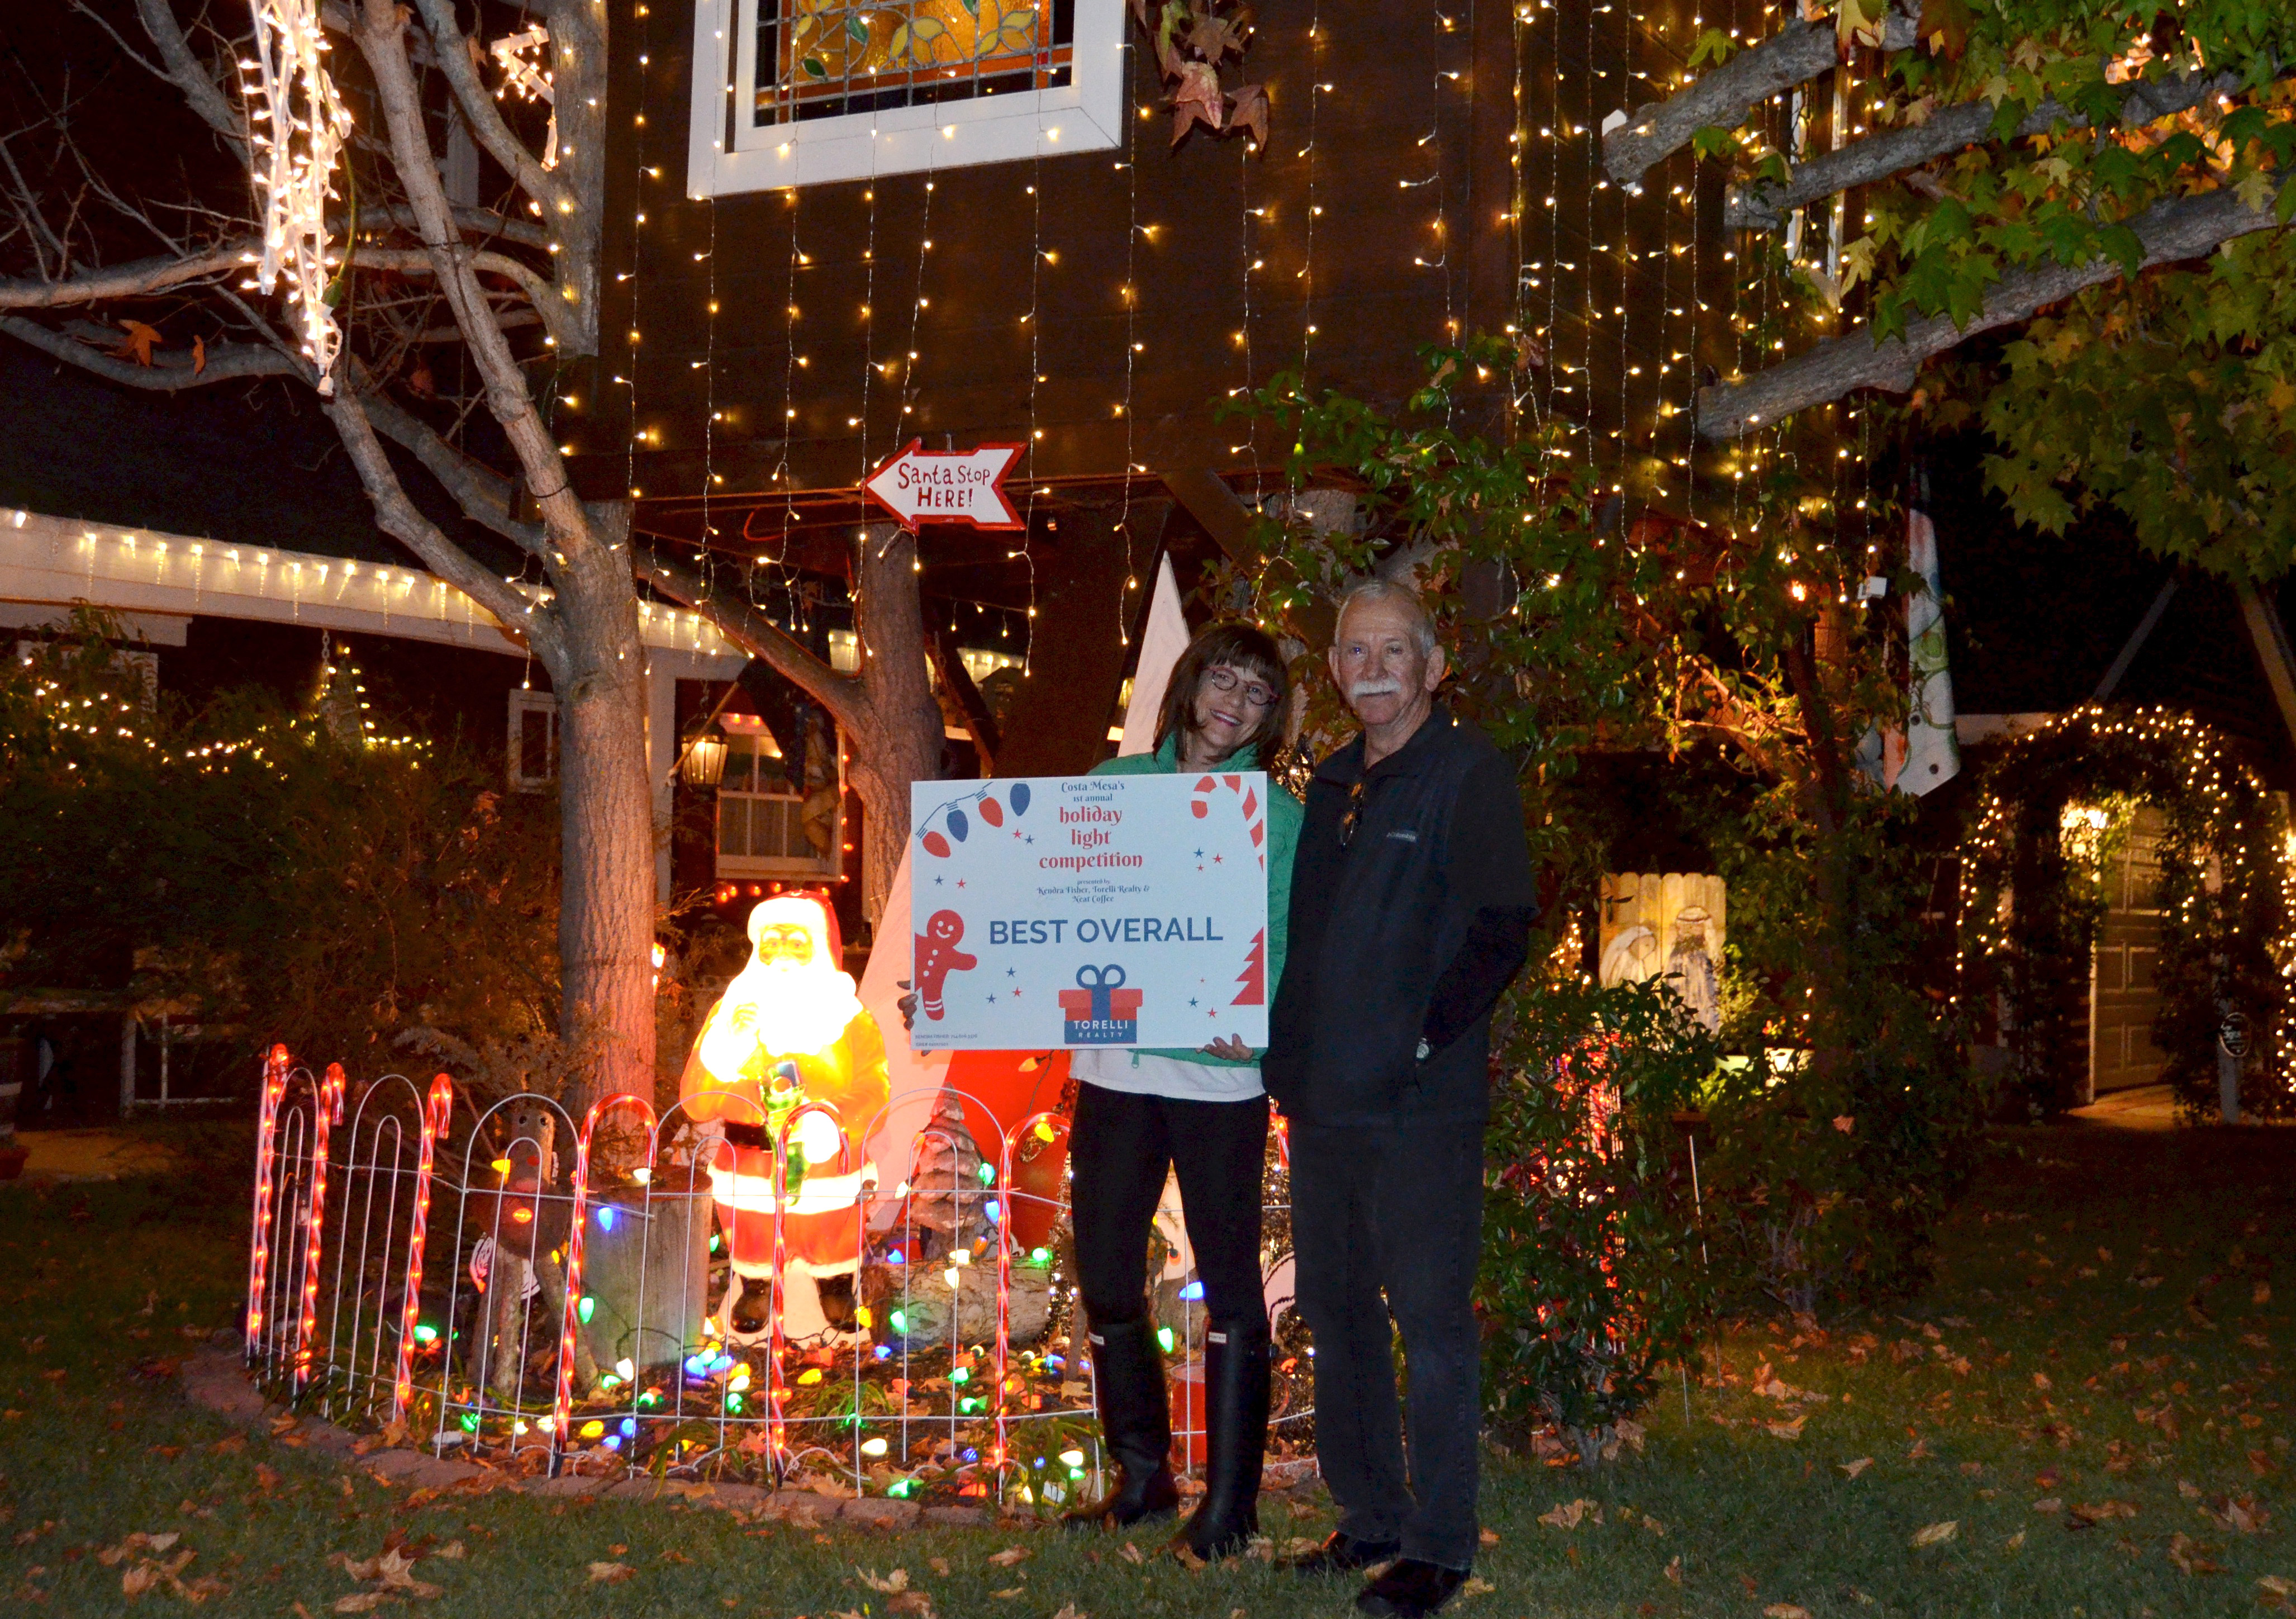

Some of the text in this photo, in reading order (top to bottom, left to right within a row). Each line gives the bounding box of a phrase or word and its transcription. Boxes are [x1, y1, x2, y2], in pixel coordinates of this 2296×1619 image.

[898, 462, 991, 489] Santa Stop
[918, 487, 973, 507] HERE!
[1061, 779, 1124, 792] Costa Mesa's
[1059, 805, 1122, 826] holiday
[1071, 828, 1111, 849] light
[1039, 852, 1143, 872] competition
[1066, 886, 1091, 894] Fisher,
[1117, 885, 1142, 894] Realty
[1092, 895, 1114, 904] Coffee
[990, 917, 1224, 944] BEST OVERALL
[1073, 1020, 1128, 1029] TORELLI
